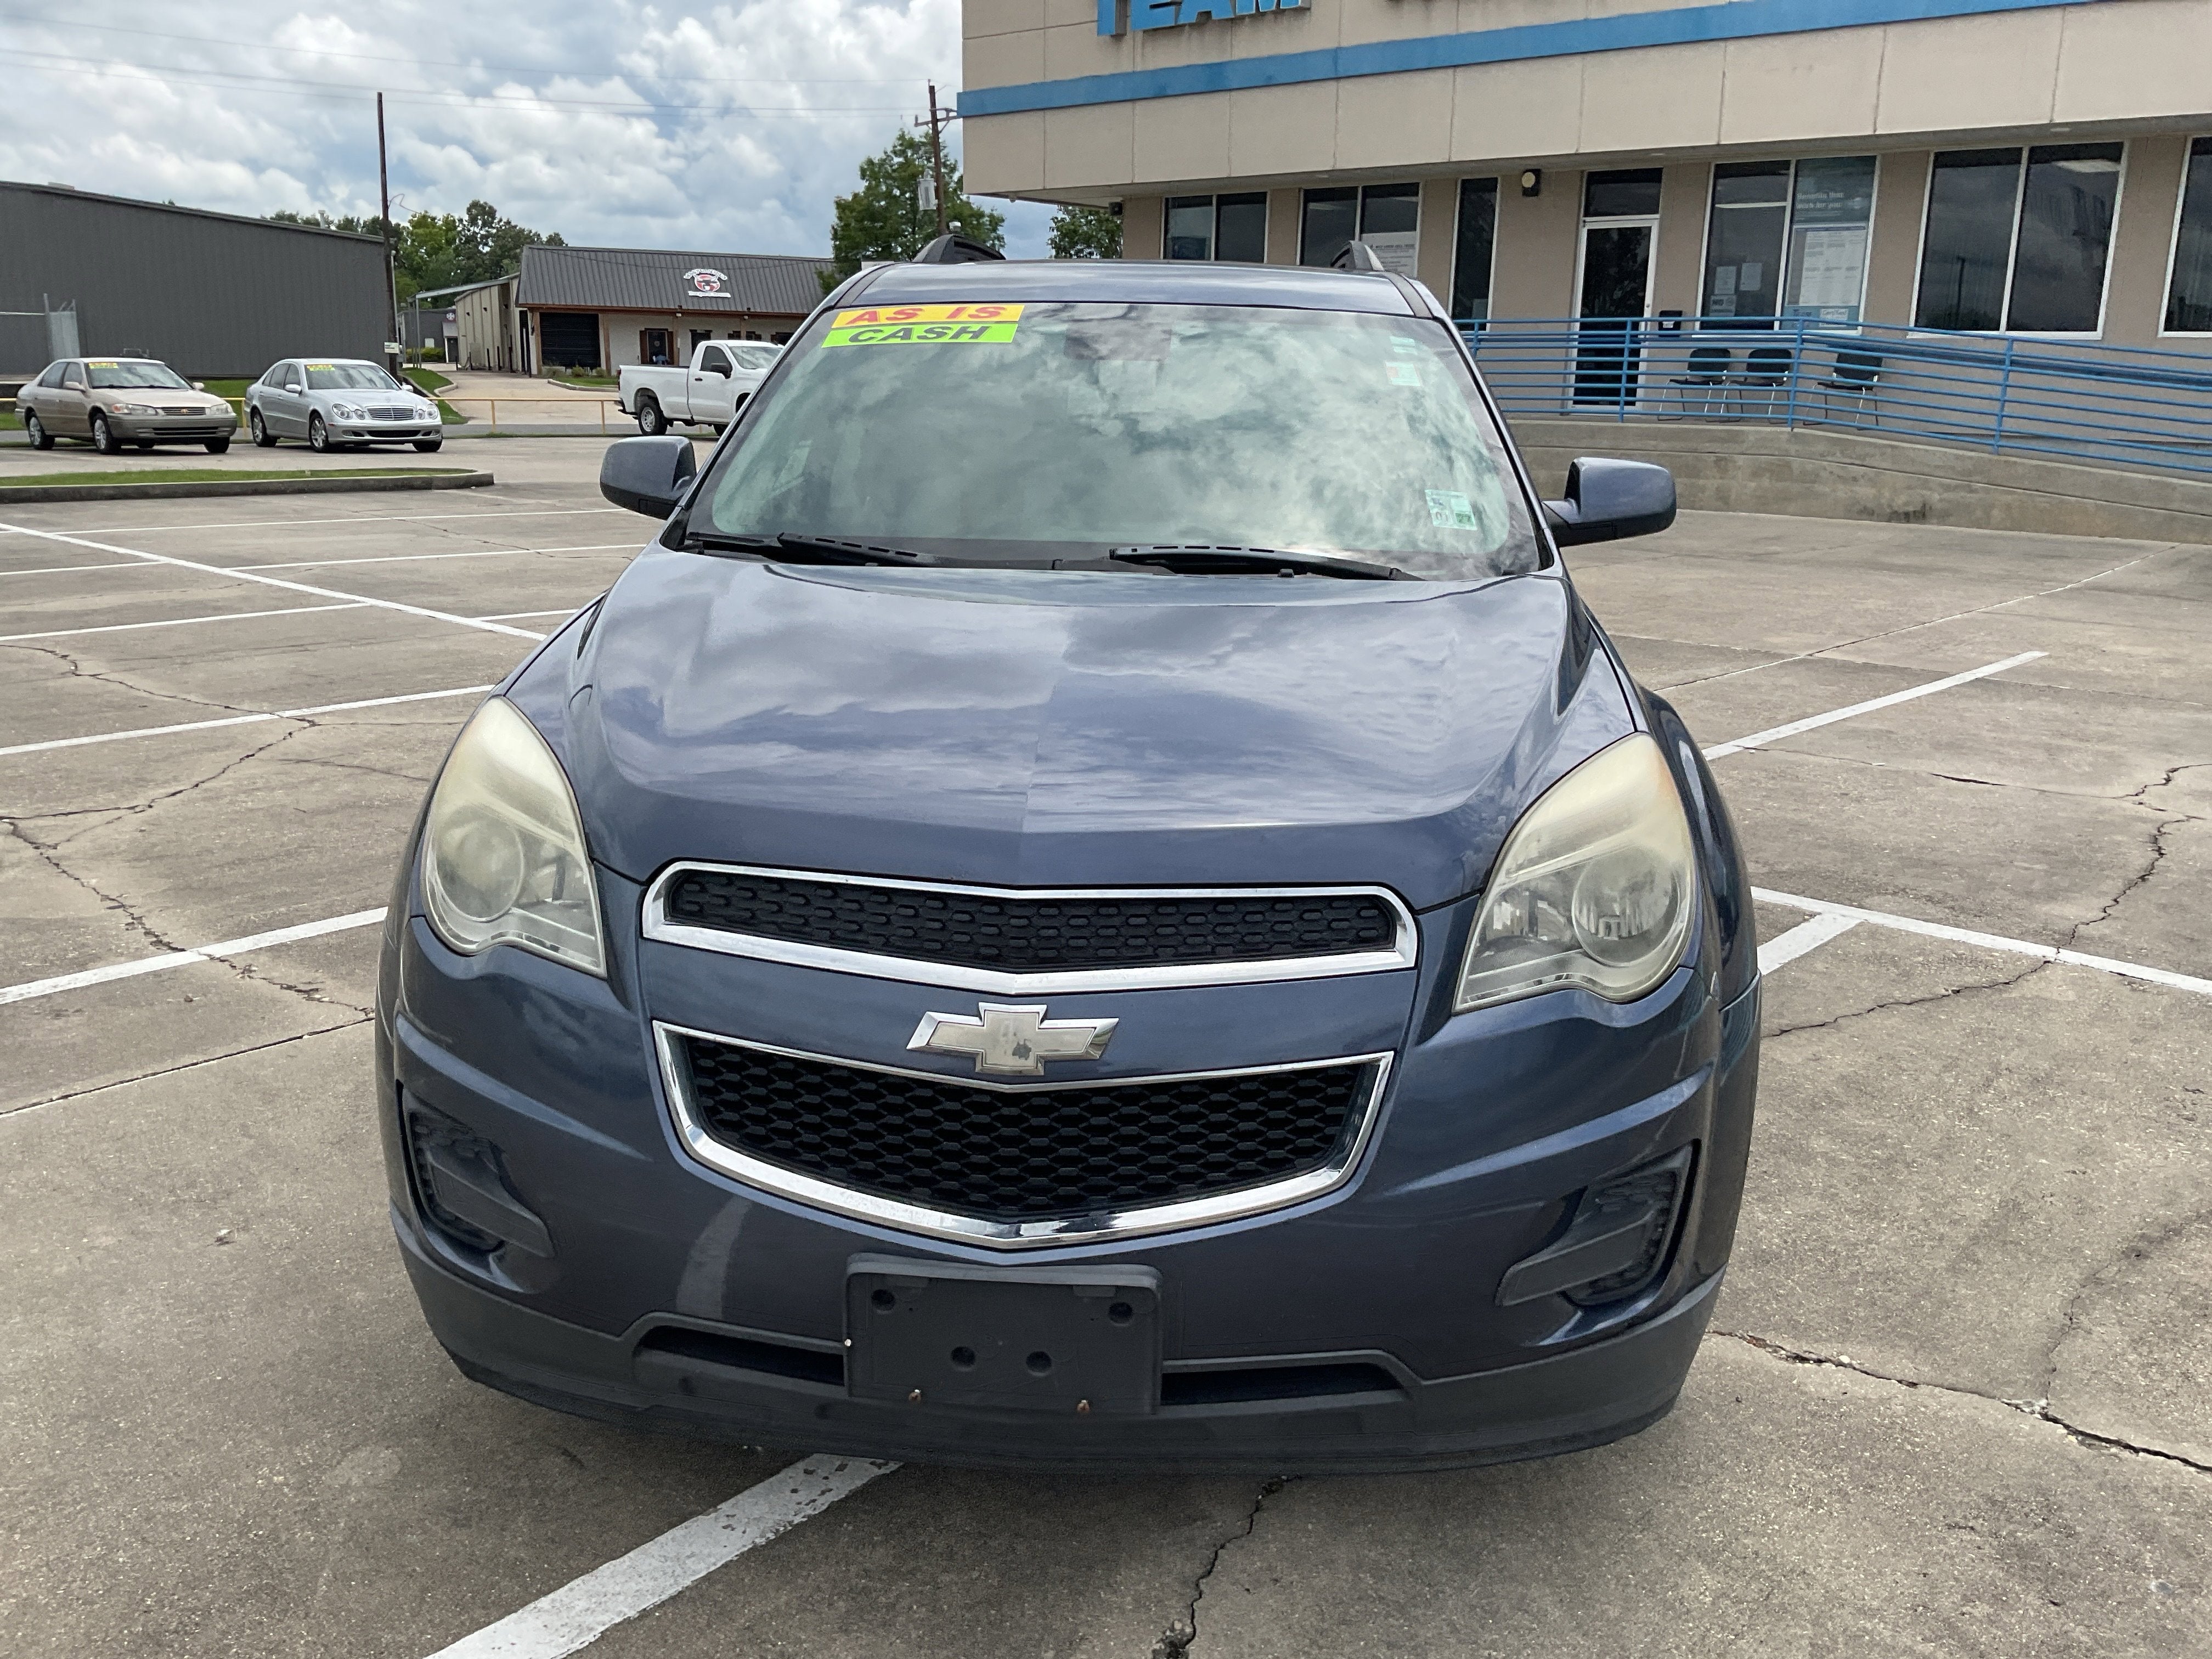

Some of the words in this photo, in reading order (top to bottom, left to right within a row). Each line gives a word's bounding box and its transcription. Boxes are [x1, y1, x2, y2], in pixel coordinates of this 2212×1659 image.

[845, 308, 924, 325] AS
[945, 306, 1007, 319] IS
[848, 325, 990, 342] CASH
